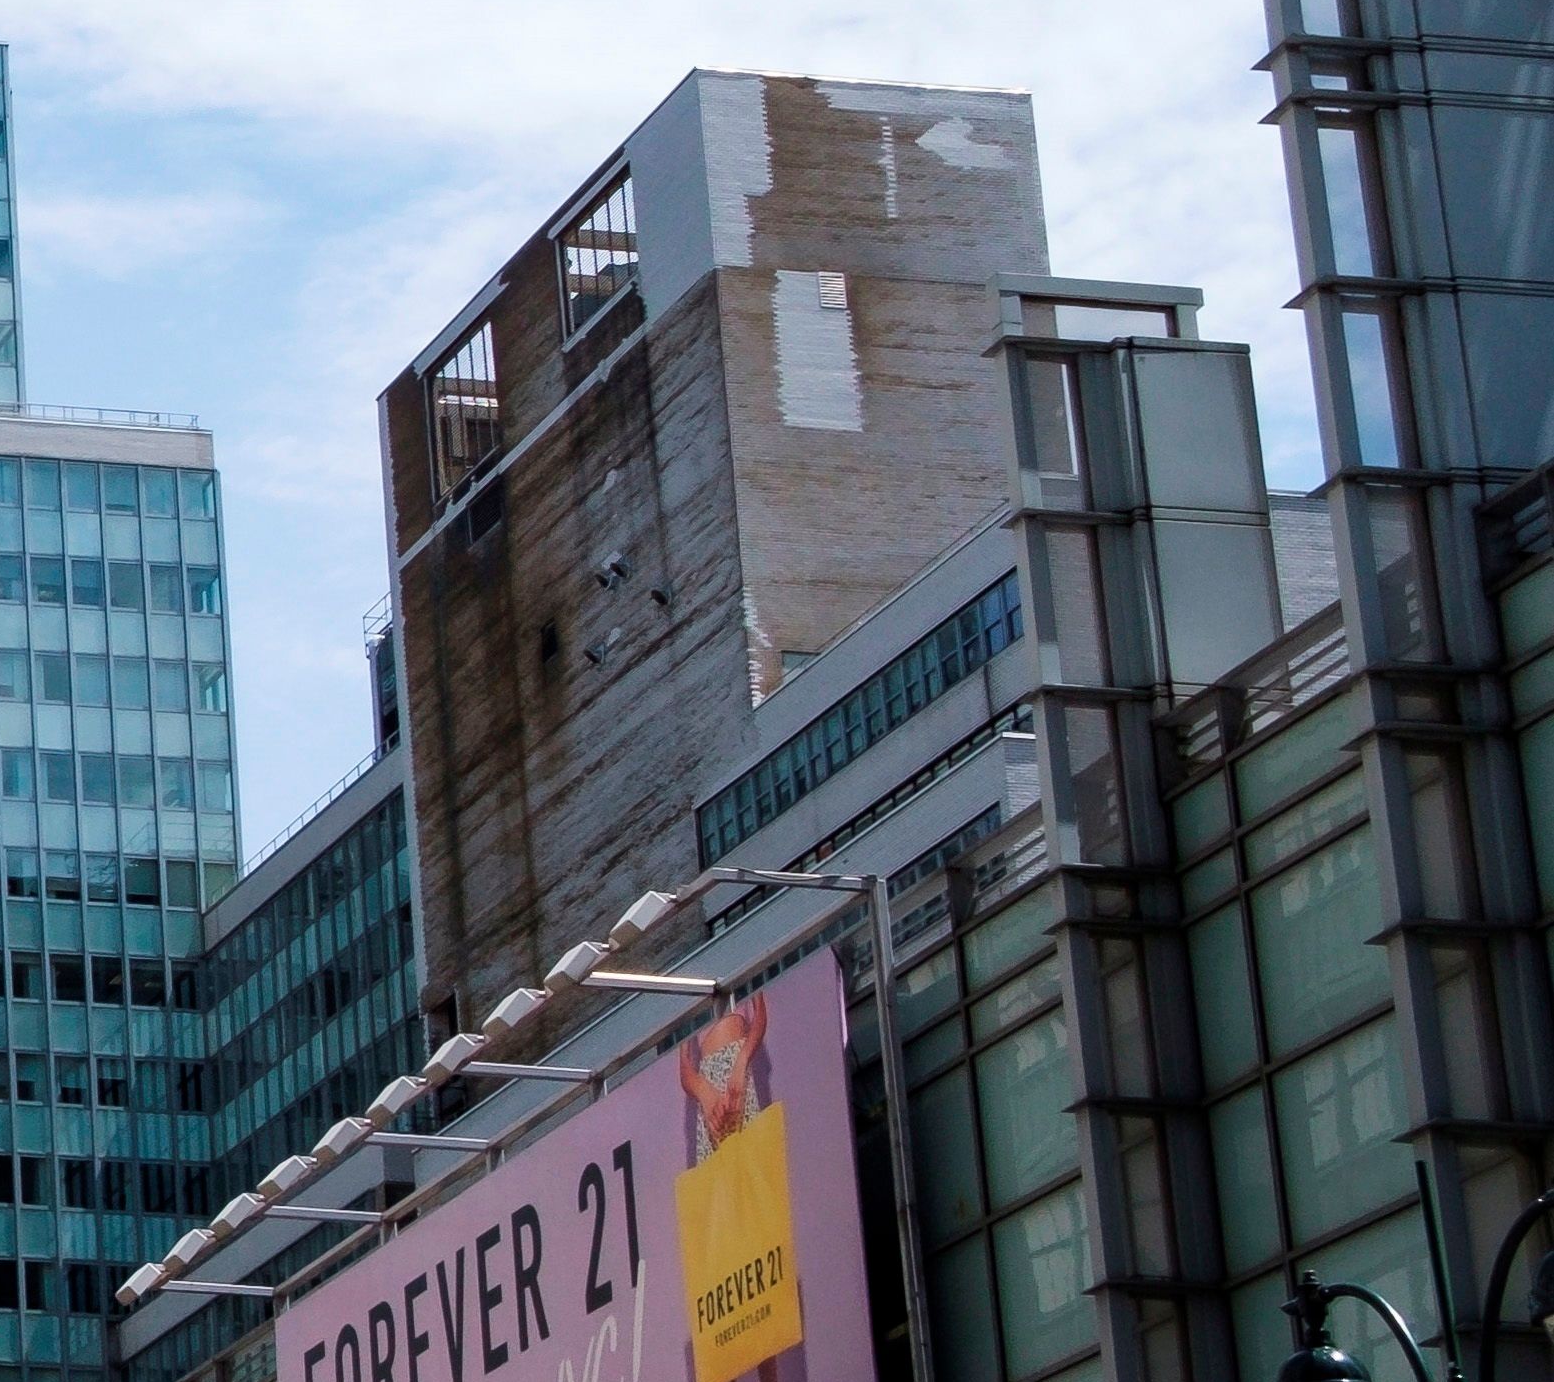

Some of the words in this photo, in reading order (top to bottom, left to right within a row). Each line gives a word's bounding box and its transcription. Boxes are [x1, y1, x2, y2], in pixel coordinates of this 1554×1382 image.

[577, 1140, 639, 1314] 21
[696, 1267, 765, 1333] FOREVER
[767, 1246, 784, 1289] 21
